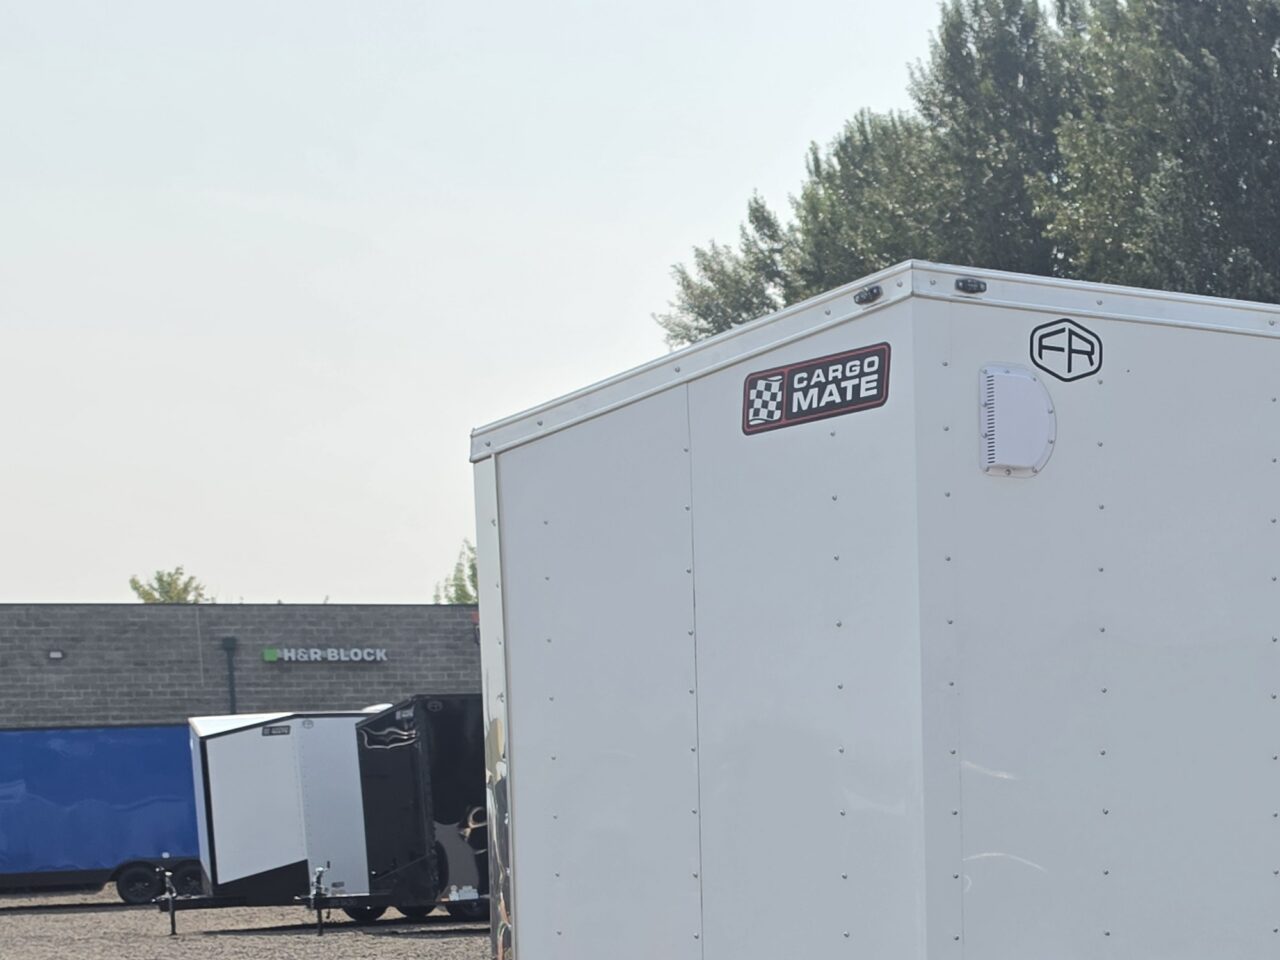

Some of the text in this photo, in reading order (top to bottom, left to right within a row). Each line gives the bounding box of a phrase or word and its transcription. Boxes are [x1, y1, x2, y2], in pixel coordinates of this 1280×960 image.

[792, 355, 880, 389] CARGO
[791, 374, 879, 413] MATE
[283, 647, 388, 661] H&R BLOCK
